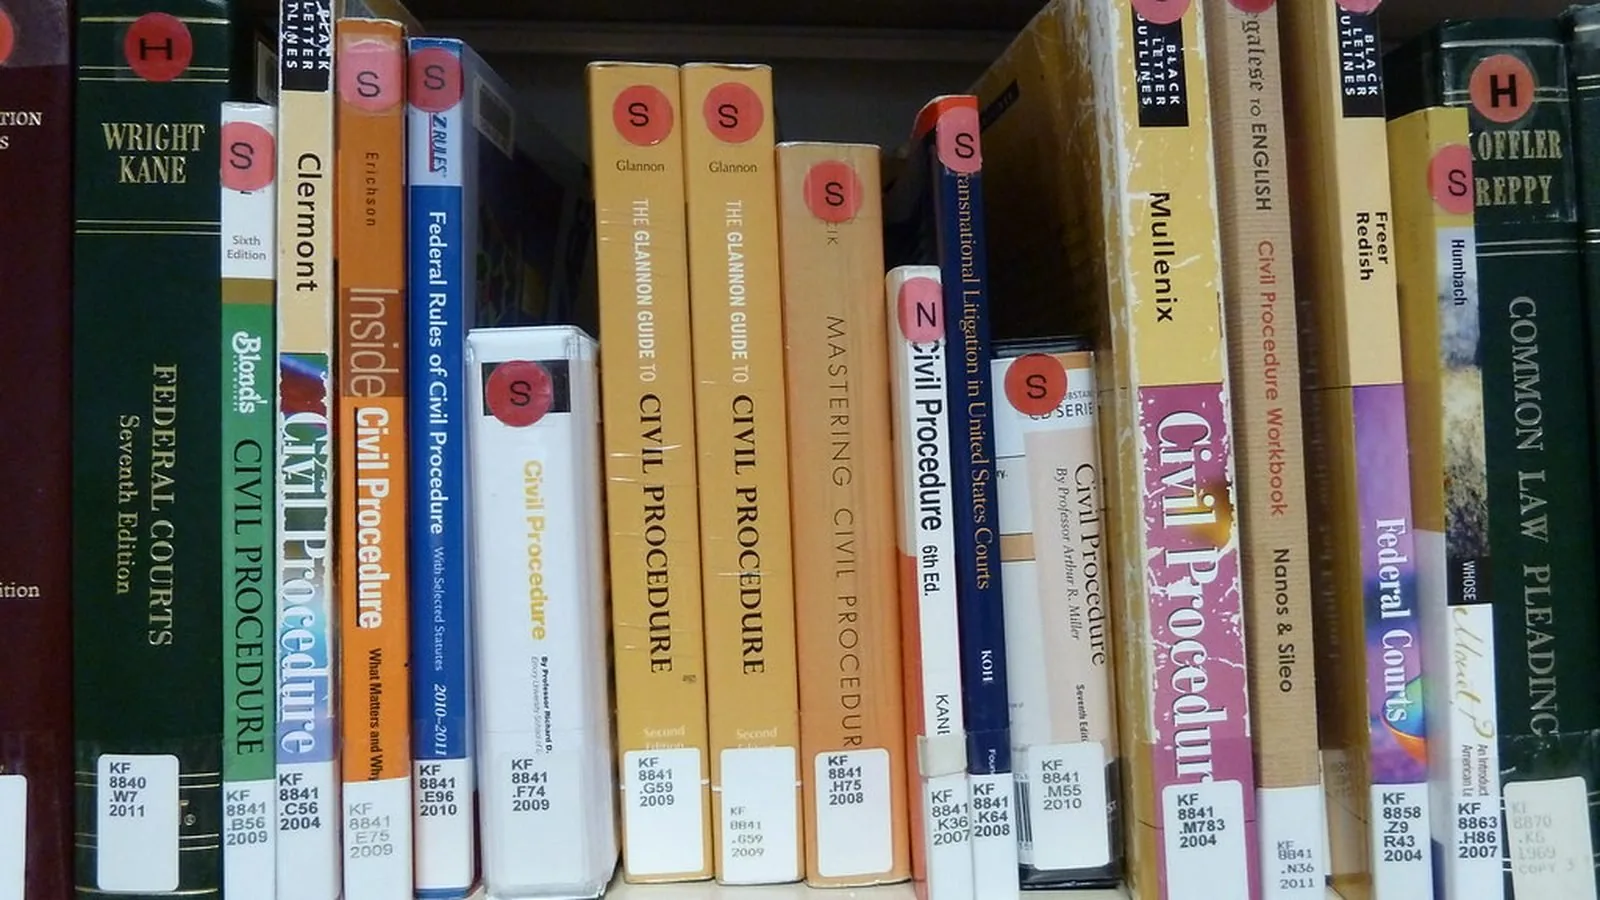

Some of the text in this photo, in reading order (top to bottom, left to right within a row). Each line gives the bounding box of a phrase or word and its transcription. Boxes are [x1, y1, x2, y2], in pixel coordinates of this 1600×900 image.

[1152, 38, 1166, 105] LETTER
[1353, 28, 1367, 95] LETTER
[1365, 35, 1378, 95] BLACK
[356, 71, 380, 97] S
[423, 64, 447, 91] S
[1166, 45, 1180, 104] BLACK
[1489, 74, 1517, 107] H
[629, 102, 648, 127] S
[718, 104, 738, 128] S
[102, 122, 205, 151] WRIGHT
[955, 132, 975, 159] S
[1472, 130, 1563, 161] OFFLER
[230, 142, 254, 170] S
[616, 160, 665, 172] Glannon
[709, 162, 757, 173] Glannon
[119, 156, 186, 184] KANE
[365, 152, 379, 227] Erichson
[825, 182, 844, 207] S
[1447, 168, 1467, 197] S
[1476, 175, 1552, 206] REPPY
[296, 152, 321, 292] Clermont
[232, 235, 260, 246] Sixth
[429, 211, 447, 286] Federal
[1357, 211, 1374, 281] Redish
[1375, 211, 1388, 265] Freer
[227, 249, 267, 261] Edition
[1149, 192, 1176, 322] Mullenix
[1450, 239, 1466, 306] Humbach
[429, 292, 447, 347] Rules
[917, 302, 935, 327] N
[232, 331, 268, 413] Blond's
[429, 354, 448, 381] of
[509, 380, 531, 406] S
[957, 172, 991, 590] ransnational Litigation in United States Courts
[1026, 374, 1047, 399] S
[429, 383, 447, 424] Civil
[1250, 98, 1296, 693] TO ENGLISH Civil Procedure Workbook Nanos & Sileo
[633, 199, 672, 673] THE GLANNON GUIDE TO CIVIL PROCEDURE
[726, 200, 765, 675] THE GLANNON GUIDE TO CIVIL PROCEDURE
[349, 288, 399, 630] Inside Civil Procedure
[912, 341, 945, 597] Civil Procedure 6th Ed.
[430, 432, 448, 535] Procedure
[523, 459, 544, 511] Civil
[116, 415, 140, 594] Seventh Edition
[148, 364, 177, 646] FEDERAL COURTS
[1509, 296, 1559, 736] COMMON LAW PLEADING
[826, 316, 863, 747] MASTERING CIVIL PROCEDUR
[434, 547, 445, 573] With
[1074, 463, 1106, 666] Civil Procedure
[277, 412, 328, 755] Civil Procedure
[527, 517, 547, 641] Procedure
[1463, 561, 1476, 600] WHOSE
[234, 439, 264, 755] CIVIL PROCEDURE
[434, 575, 445, 624] Selected
[1156, 412, 1227, 783] Civil Procedur
[1376, 518, 1412, 723] Federal Courts
[435, 625, 446, 671] Statutes
[981, 649, 993, 681] KOH
[368, 648, 382, 752] What Matters and
[110, 762, 130, 774] KF
[420, 764, 441, 776] KF
[512, 759, 534, 770] KF
[828, 756, 848, 766] KF
[828, 767, 862, 779] 8841
[109, 777, 146, 789] 8840
[280, 774, 303, 785] KF
[419, 777, 456, 789] 8841
[511, 771, 547, 783] 8841
[639, 769, 673, 780] 8841
[829, 780, 862, 792] .H75
[1042, 773, 1079, 783] 8841
[109, 791, 137, 803] .W7
[280, 788, 319, 800] 8841
[420, 791, 454, 803] .E96
[512, 786, 546, 797] .F74
[639, 783, 673, 794] .G59
[829, 793, 863, 805] 2008
[973, 783, 995, 796] KF
[1044, 786, 1081, 797] .M55
[1177, 794, 1199, 806] KF
[1383, 793, 1405, 805] KF
[109, 805, 145, 817] 2011
[226, 803, 265, 815] 8841
[280, 802, 318, 815] .C56
[420, 804, 457, 816] 2010
[512, 799, 549, 811] 2009
[639, 795, 674, 807] 2009
[931, 803, 968, 817] 8841
[973, 796, 1009, 810] 8841
[1043, 799, 1082, 810] 2010
[1177, 806, 1214, 819] 8841
[1383, 806, 1421, 819] 8858
[1458, 802, 1480, 814] KF
[280, 817, 321, 830] 2004
[349, 816, 390, 829] 8841
[933, 817, 968, 830] .K36
[974, 810, 1009, 823] .K64
[1179, 819, 1225, 833] .M783
[1384, 820, 1409, 834] .Z9
[1458, 816, 1497, 829] 8863
[226, 832, 268, 846] 2009
[933, 829, 970, 845] 2007
[973, 824, 1010, 837] 2008
[1179, 834, 1216, 848] 2004
[1384, 835, 1415, 847] R43
[1458, 831, 1496, 844] .H86
[350, 844, 393, 858] 2009
[1384, 848, 1422, 862] 2004
[1459, 845, 1498, 859] 2007
